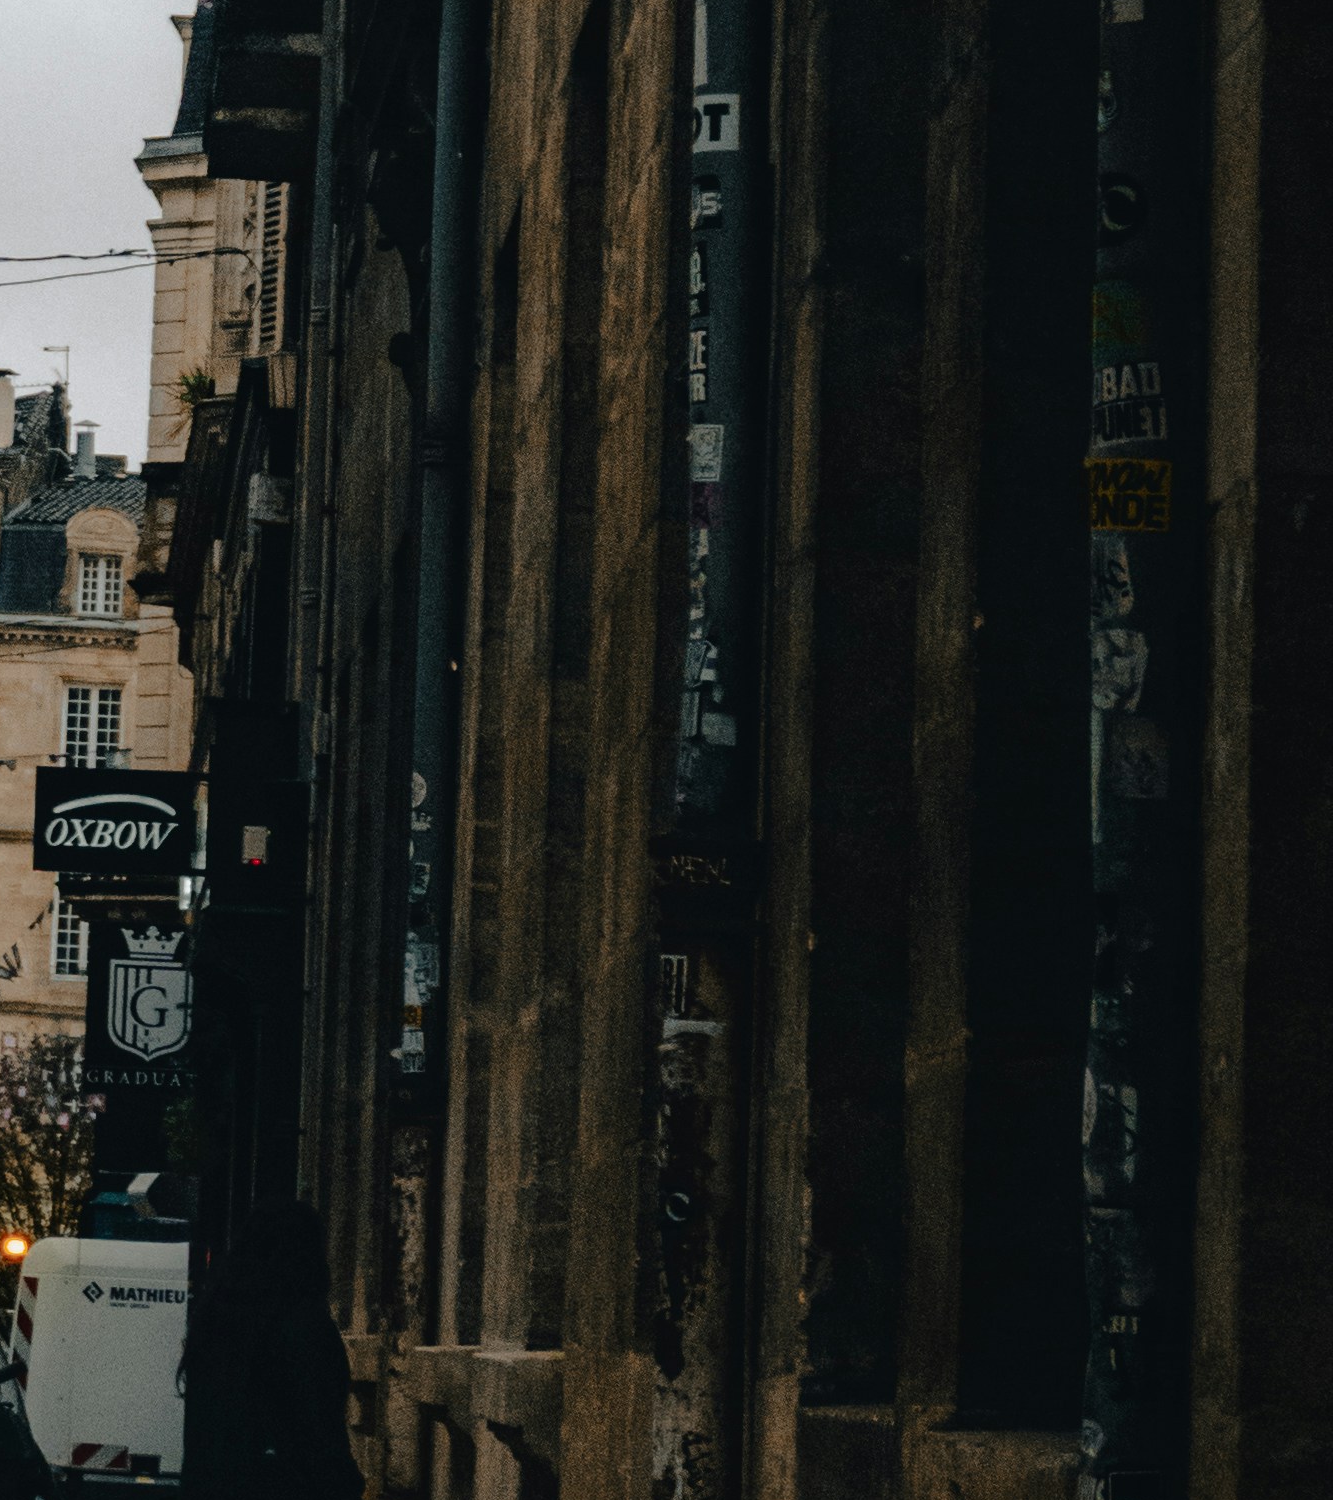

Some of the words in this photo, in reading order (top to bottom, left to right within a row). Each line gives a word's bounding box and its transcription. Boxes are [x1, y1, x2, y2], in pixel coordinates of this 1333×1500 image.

[44, 817, 180, 851] OXBOW
[130, 985, 169, 1029] G
[110, 1287, 185, 1304] MATHIEU
